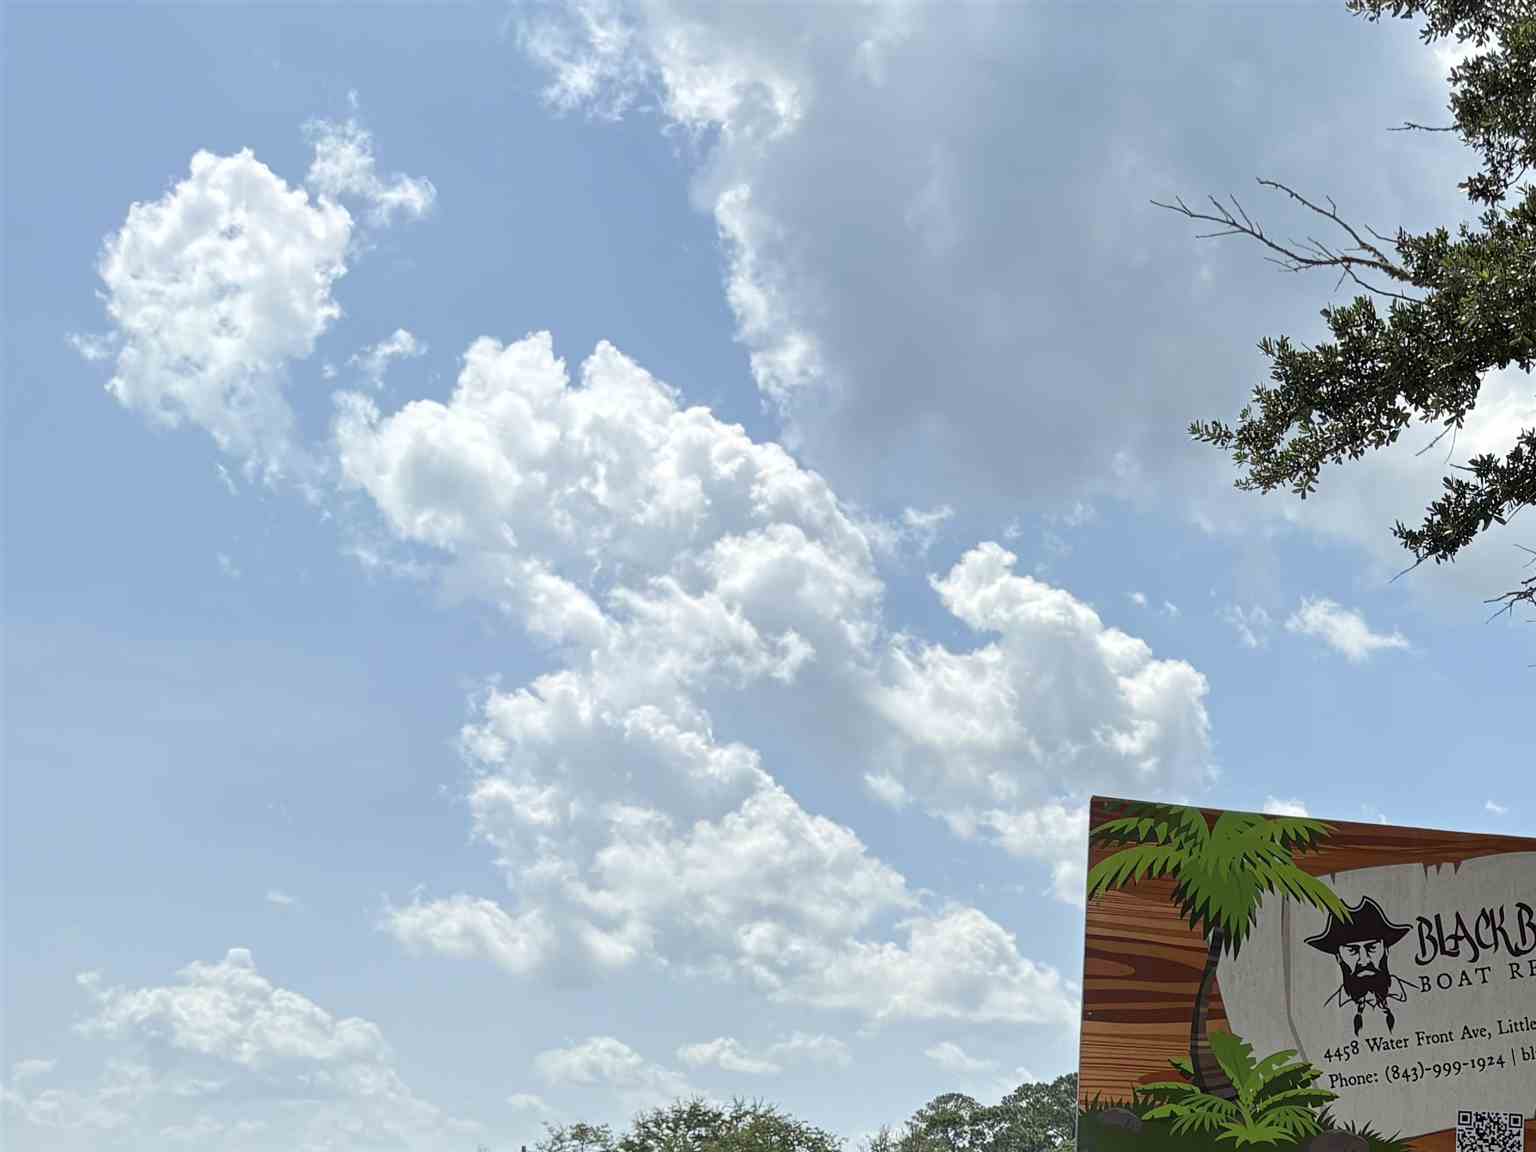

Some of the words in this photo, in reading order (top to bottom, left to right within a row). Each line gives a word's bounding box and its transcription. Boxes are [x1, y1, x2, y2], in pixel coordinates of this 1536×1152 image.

[1419, 966, 1492, 993] BOAT
[1324, 1040, 1359, 1062] 4458
[1366, 1037, 1409, 1052] Water
[1416, 1030, 1454, 1046] Front
[1461, 1025, 1492, 1040] Ave,
[1497, 1017, 1536, 1035] Little
[1329, 1072, 1378, 1089] Phone:
[1385, 1054, 1506, 1084] (843)-999-1924
